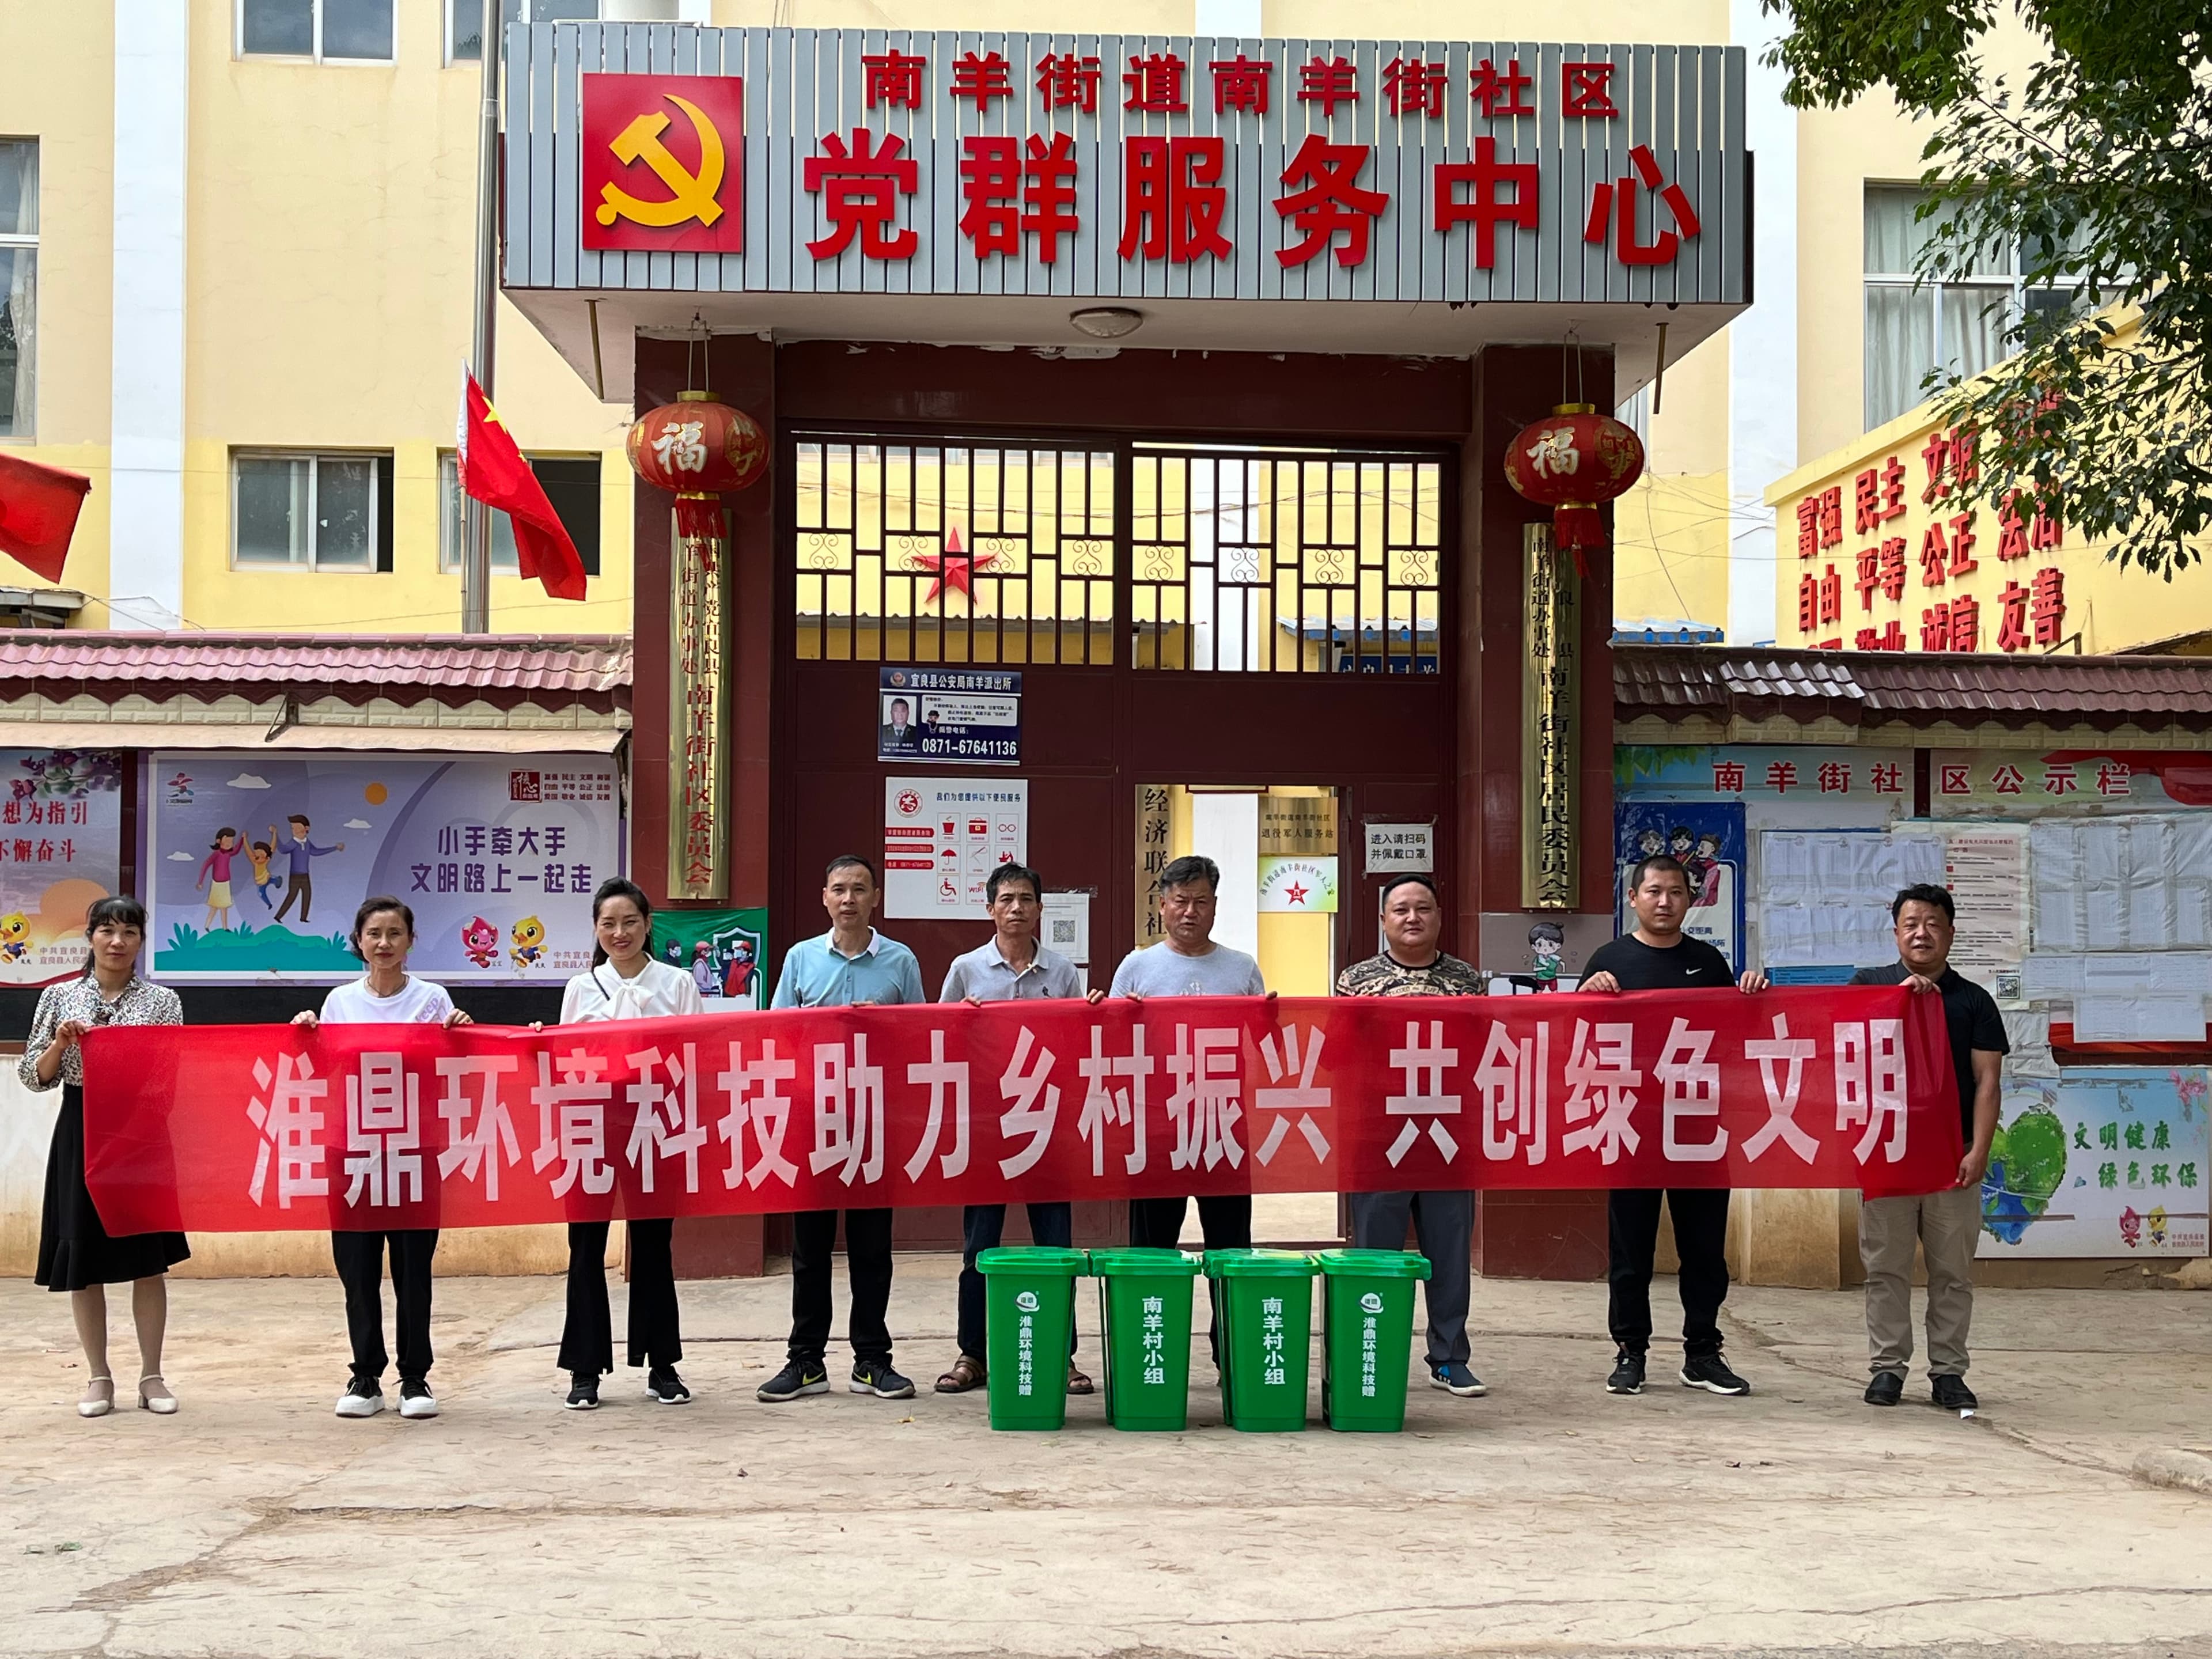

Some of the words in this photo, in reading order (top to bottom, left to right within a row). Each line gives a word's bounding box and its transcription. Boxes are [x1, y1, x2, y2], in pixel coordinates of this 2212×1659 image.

[863, 50, 1619, 119] 南羊街道南羊街社区
[804, 128, 1699, 270] 党群服务中心
[651, 421, 707, 475] 福
[1527, 426, 1580, 479] 福
[1797, 486, 1842, 559] 富强
[1855, 457, 1907, 535] 民主
[1921, 419, 1979, 505] 文明
[1799, 564, 1841, 632] 自由
[1854, 537, 1907, 611] 平等
[1919, 512, 1978, 587] 公正
[682, 544, 699, 674] 羊街道办事处
[1997, 567, 2067, 652] 友善
[911, 673, 1011, 691] 宜良县公安局南羊派出所
[922, 738, 1017, 756] 0871-67641136
[1713, 761, 1904, 794] 南羊街社
[1941, 764, 2131, 796] 区公示栏
[2, 801, 88, 825] 想为指引
[1262, 828, 1334, 839] 退役军人服务站
[1371, 834, 1426, 844] 进入请扫码
[438, 827, 565, 856] 小手牵大手
[1144, 788, 1168, 937] 经济联合社
[1371, 849, 1427, 859] 并佩戴口罩
[411, 863, 592, 893] 文明路上一起走
[246, 1021, 1331, 1210] 淮鼎环境科技助力乡村振兴
[1386, 1012, 1907, 1168] 共创绿色文明
[2074, 1120, 2171, 1151] 文明健康
[2097, 1160, 2199, 1190] 绿色环保
[1142, 1296, 1165, 1384] 南羊村小组
[1262, 1297, 1286, 1385] 南羊村小组
